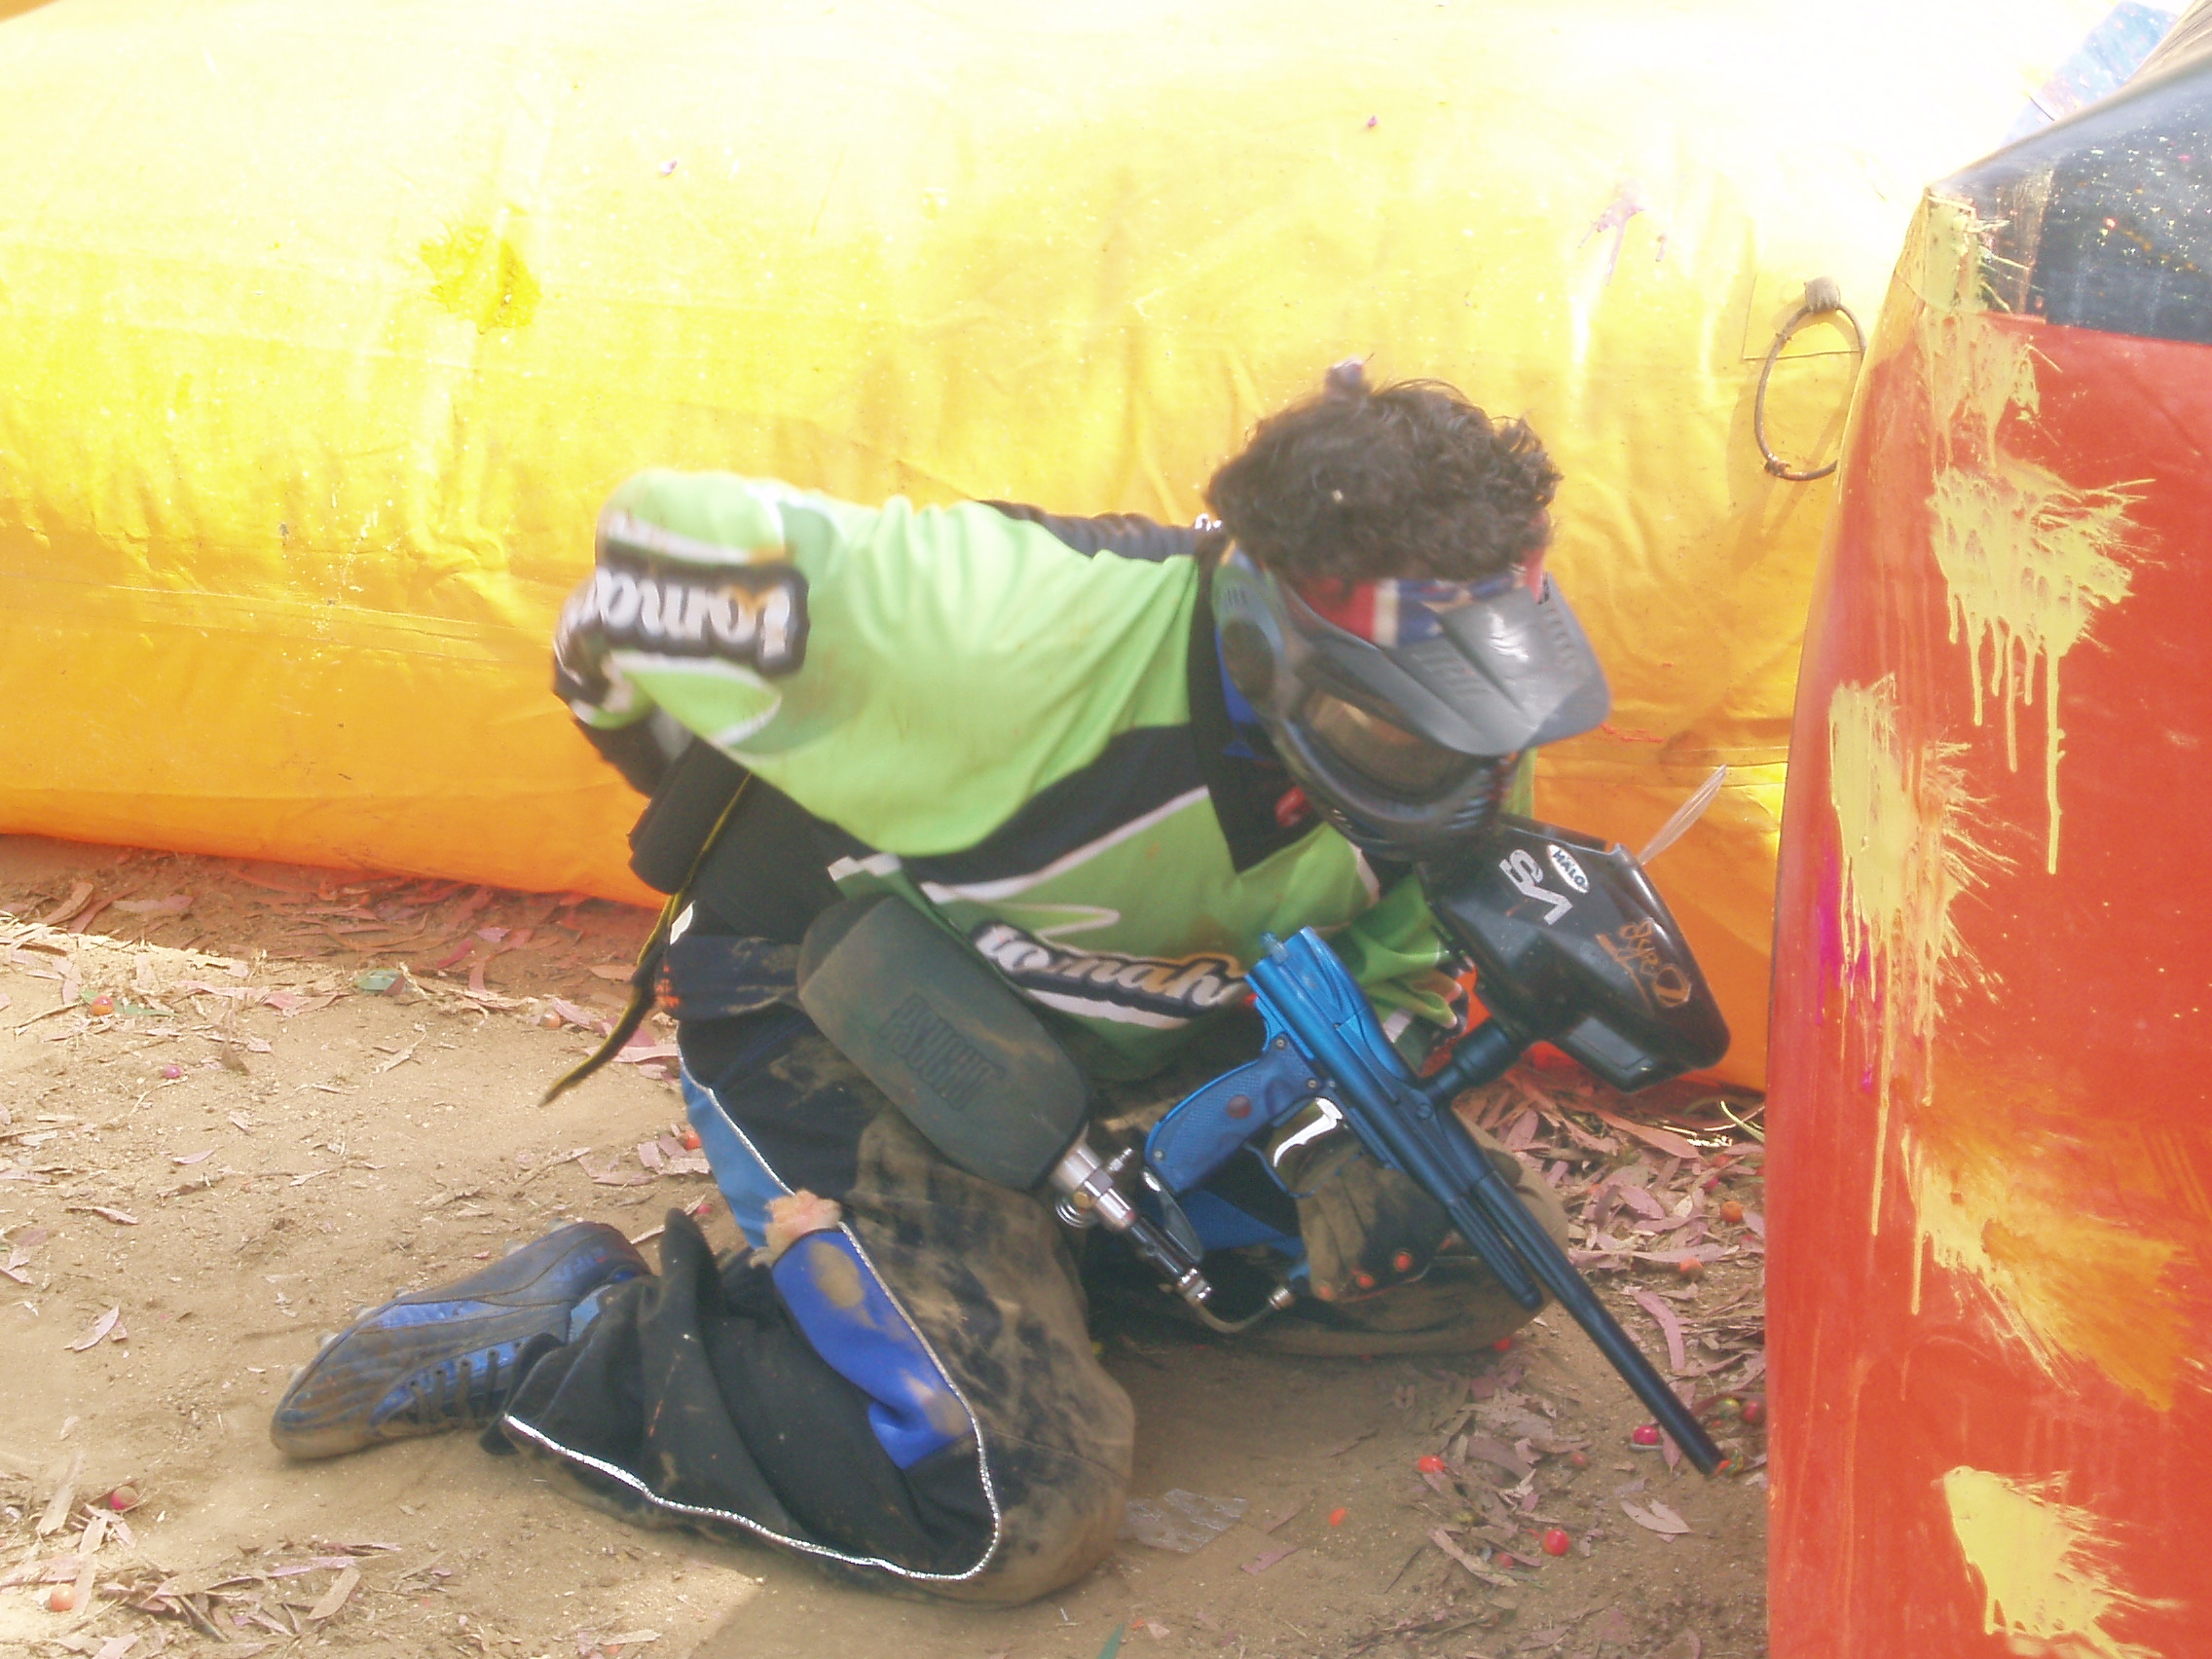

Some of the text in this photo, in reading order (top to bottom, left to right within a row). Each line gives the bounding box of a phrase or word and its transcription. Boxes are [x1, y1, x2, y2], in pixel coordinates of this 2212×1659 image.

[563, 565, 792, 659] toma
[1552, 849, 1586, 888] HALO
[975, 924, 1248, 1007] tomah
[878, 993, 1003, 1111] PSYCHO
